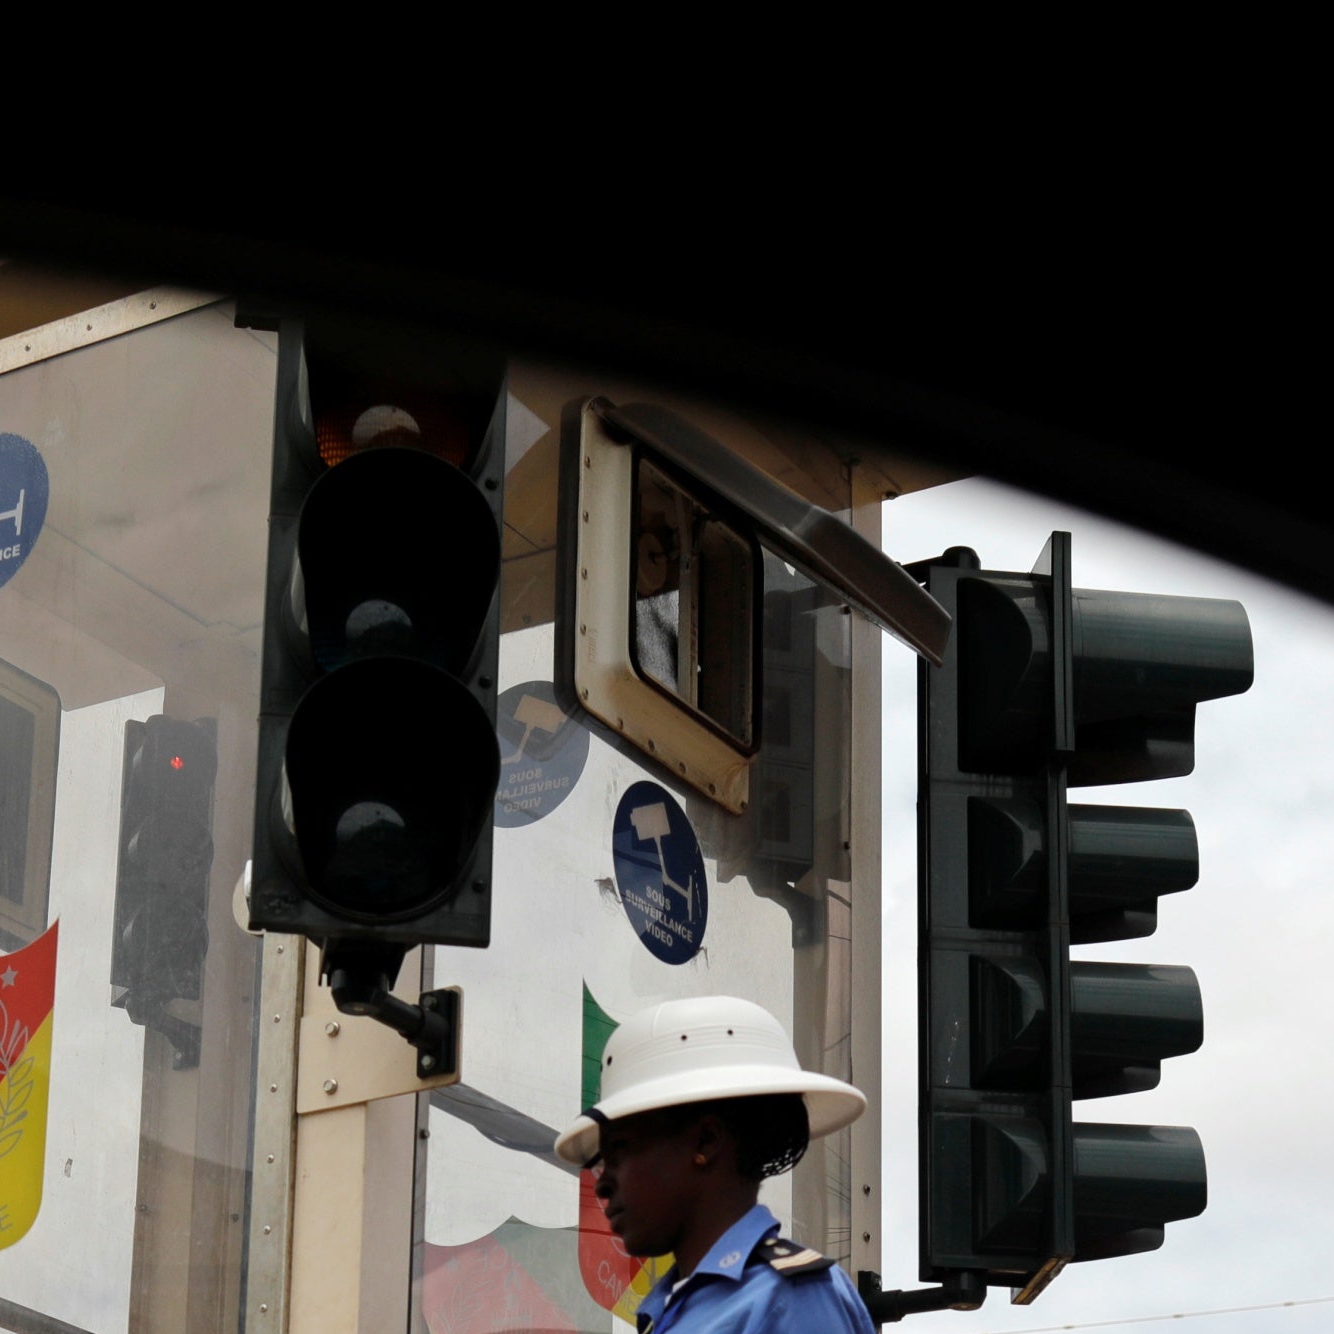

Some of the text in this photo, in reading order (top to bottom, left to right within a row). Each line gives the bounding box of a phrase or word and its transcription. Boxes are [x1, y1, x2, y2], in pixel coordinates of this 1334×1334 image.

[646, 886, 671, 911] SOUS
[626, 889, 693, 943] SURVEILLANCE
[646, 920, 673, 947] VIDEO
